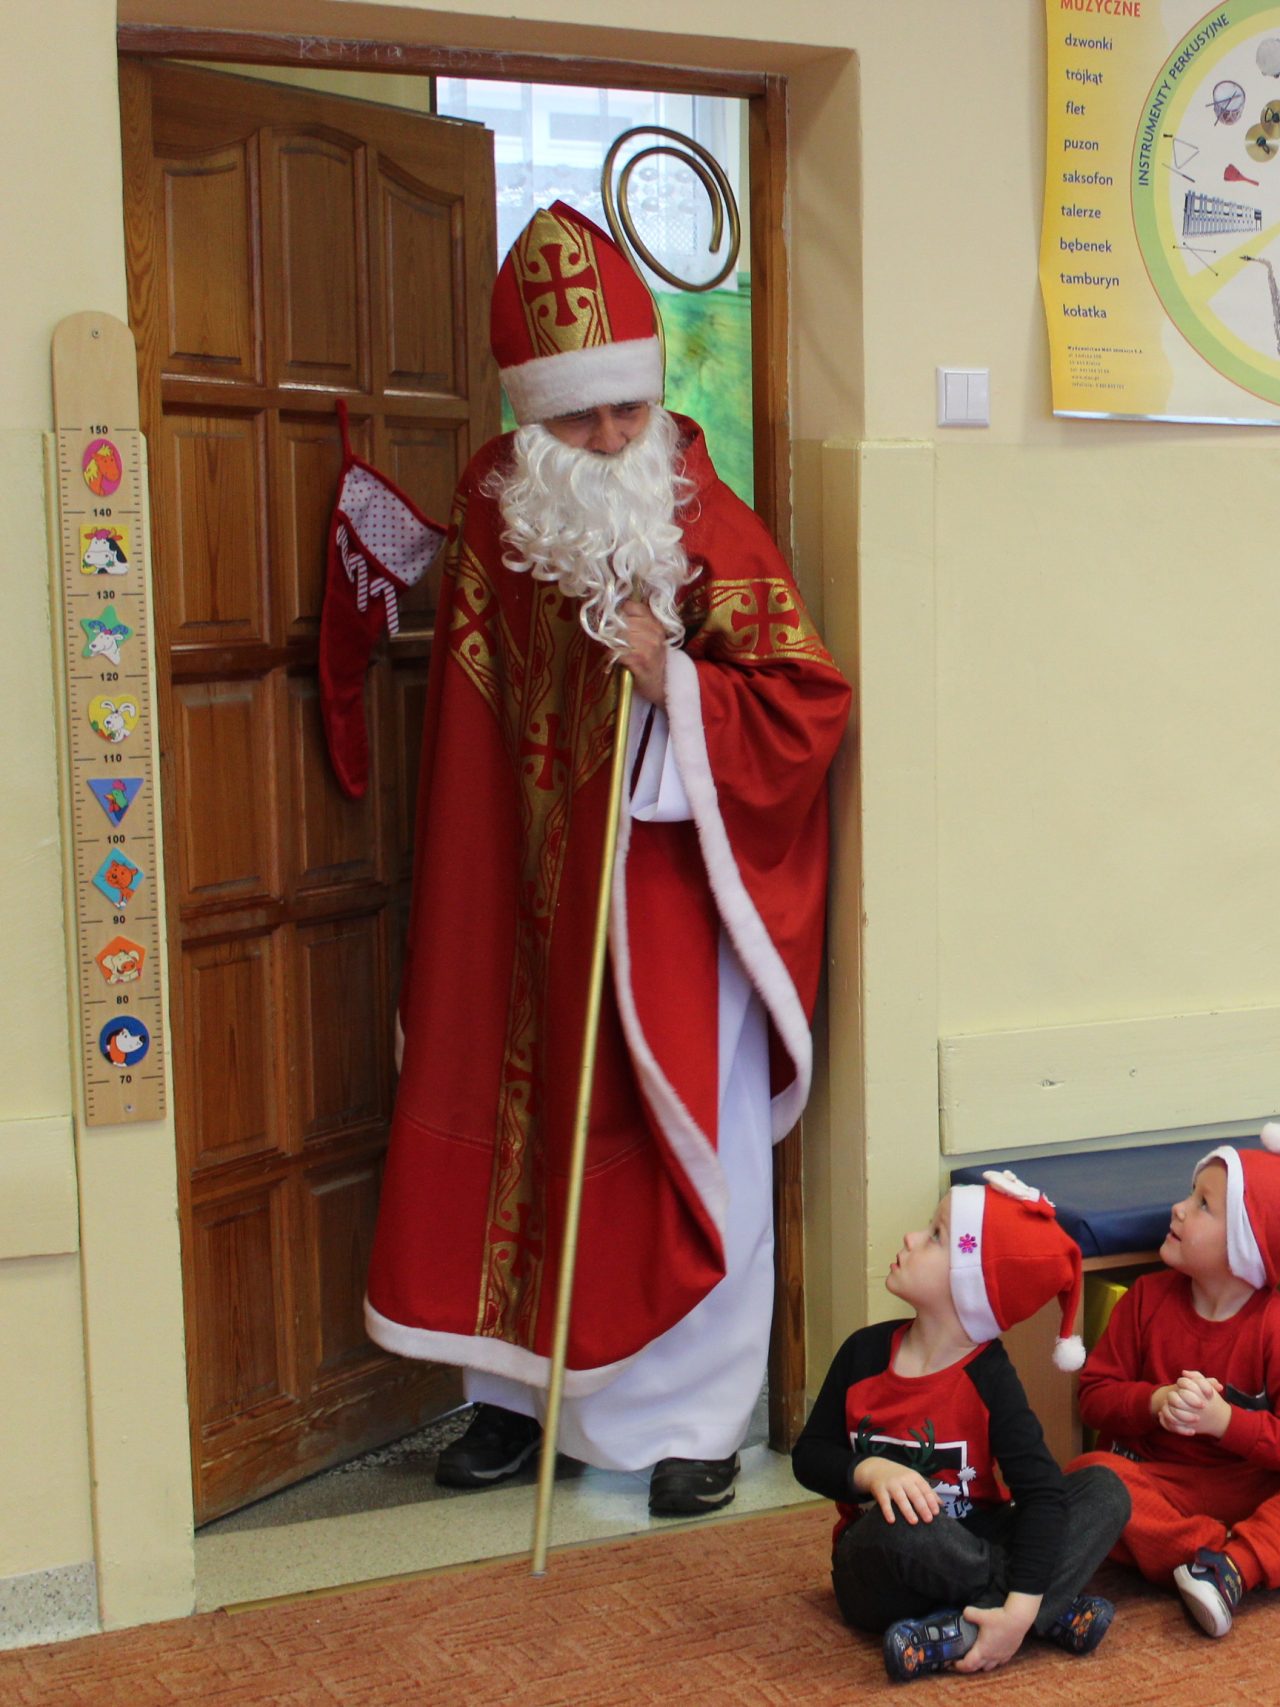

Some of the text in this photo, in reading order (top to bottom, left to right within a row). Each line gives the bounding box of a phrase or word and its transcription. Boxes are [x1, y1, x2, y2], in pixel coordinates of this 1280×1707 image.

[1060, 0, 1141, 17] MUZYCZNE
[1064, 33, 1113, 51] dzwonki
[1065, 68, 1103, 84] trójkąt
[1139, 13, 1230, 186] INSTRUMENTY PERKUSYJNE
[1065, 101, 1086, 116] flet
[1064, 138, 1099, 152] puzon
[1062, 171, 1113, 186] saksofon
[1061, 204, 1101, 219] talerze
[1059, 238, 1112, 254] bębenek
[1060, 272, 1120, 289] tamburyn
[1062, 304, 1107, 319] kołatka
[89, 426, 108, 435] 150
[93, 508, 112, 517] 140
[96, 591, 115, 600] 130
[100, 672, 119, 681] 120
[103, 754, 122, 763] 110
[107, 835, 126, 844] 100
[113, 915, 126, 925] 90
[116, 996, 129, 1005] 80
[119, 1075, 132, 1084] 70
